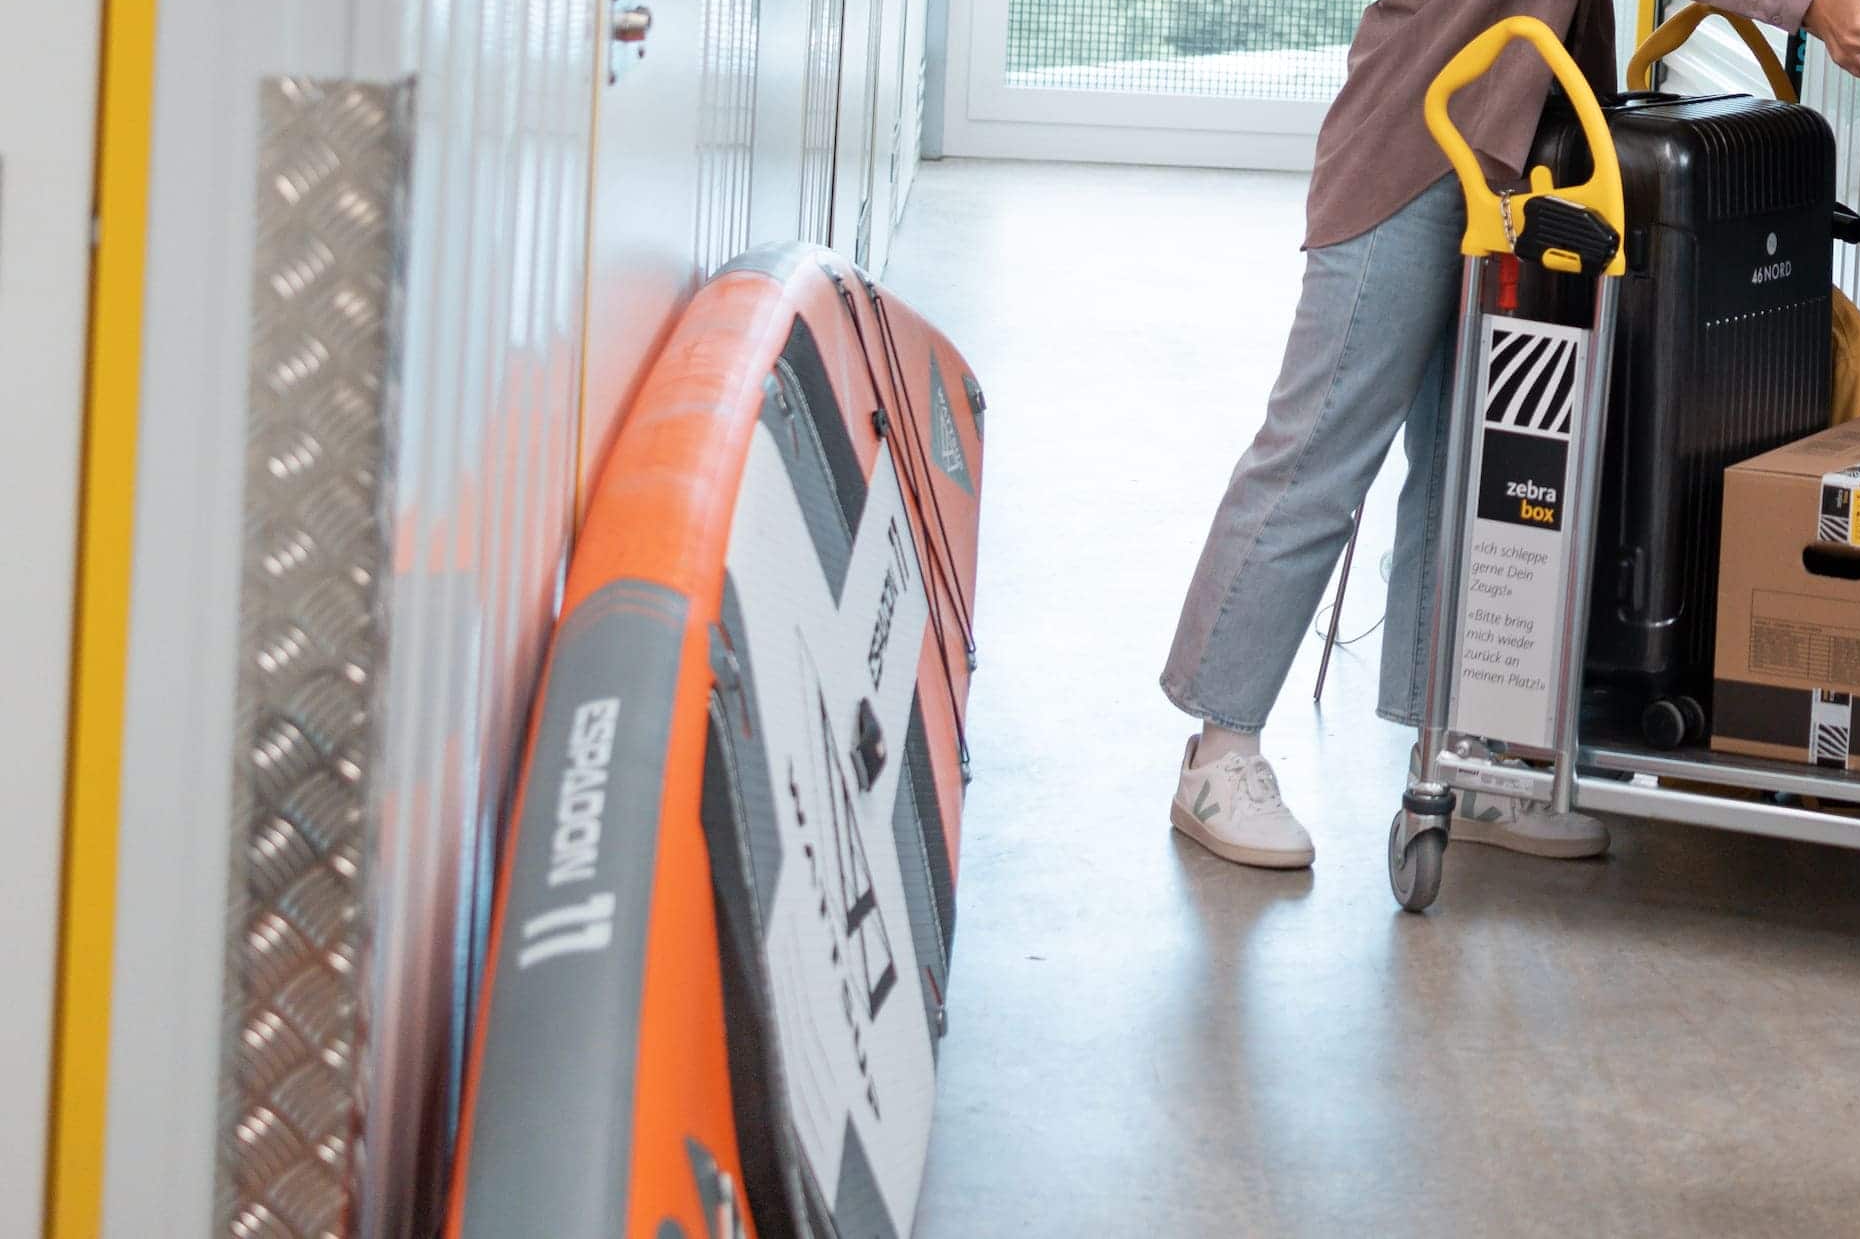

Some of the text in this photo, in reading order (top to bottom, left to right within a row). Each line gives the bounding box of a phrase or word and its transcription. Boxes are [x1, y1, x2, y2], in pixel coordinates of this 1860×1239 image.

[1506, 479, 1557, 503] zebra
[1521, 499, 1555, 523] box
[1501, 545, 1549, 565] schleppe
[1472, 561, 1535, 581] gerne Dein
[1504, 613, 1535, 634] bring
[1466, 629, 1536, 649] mich wieder
[1463, 648, 1520, 668] zurück an
[1463, 667, 1505, 685] meinen
[516, 697, 621, 971] ESPADON 11
